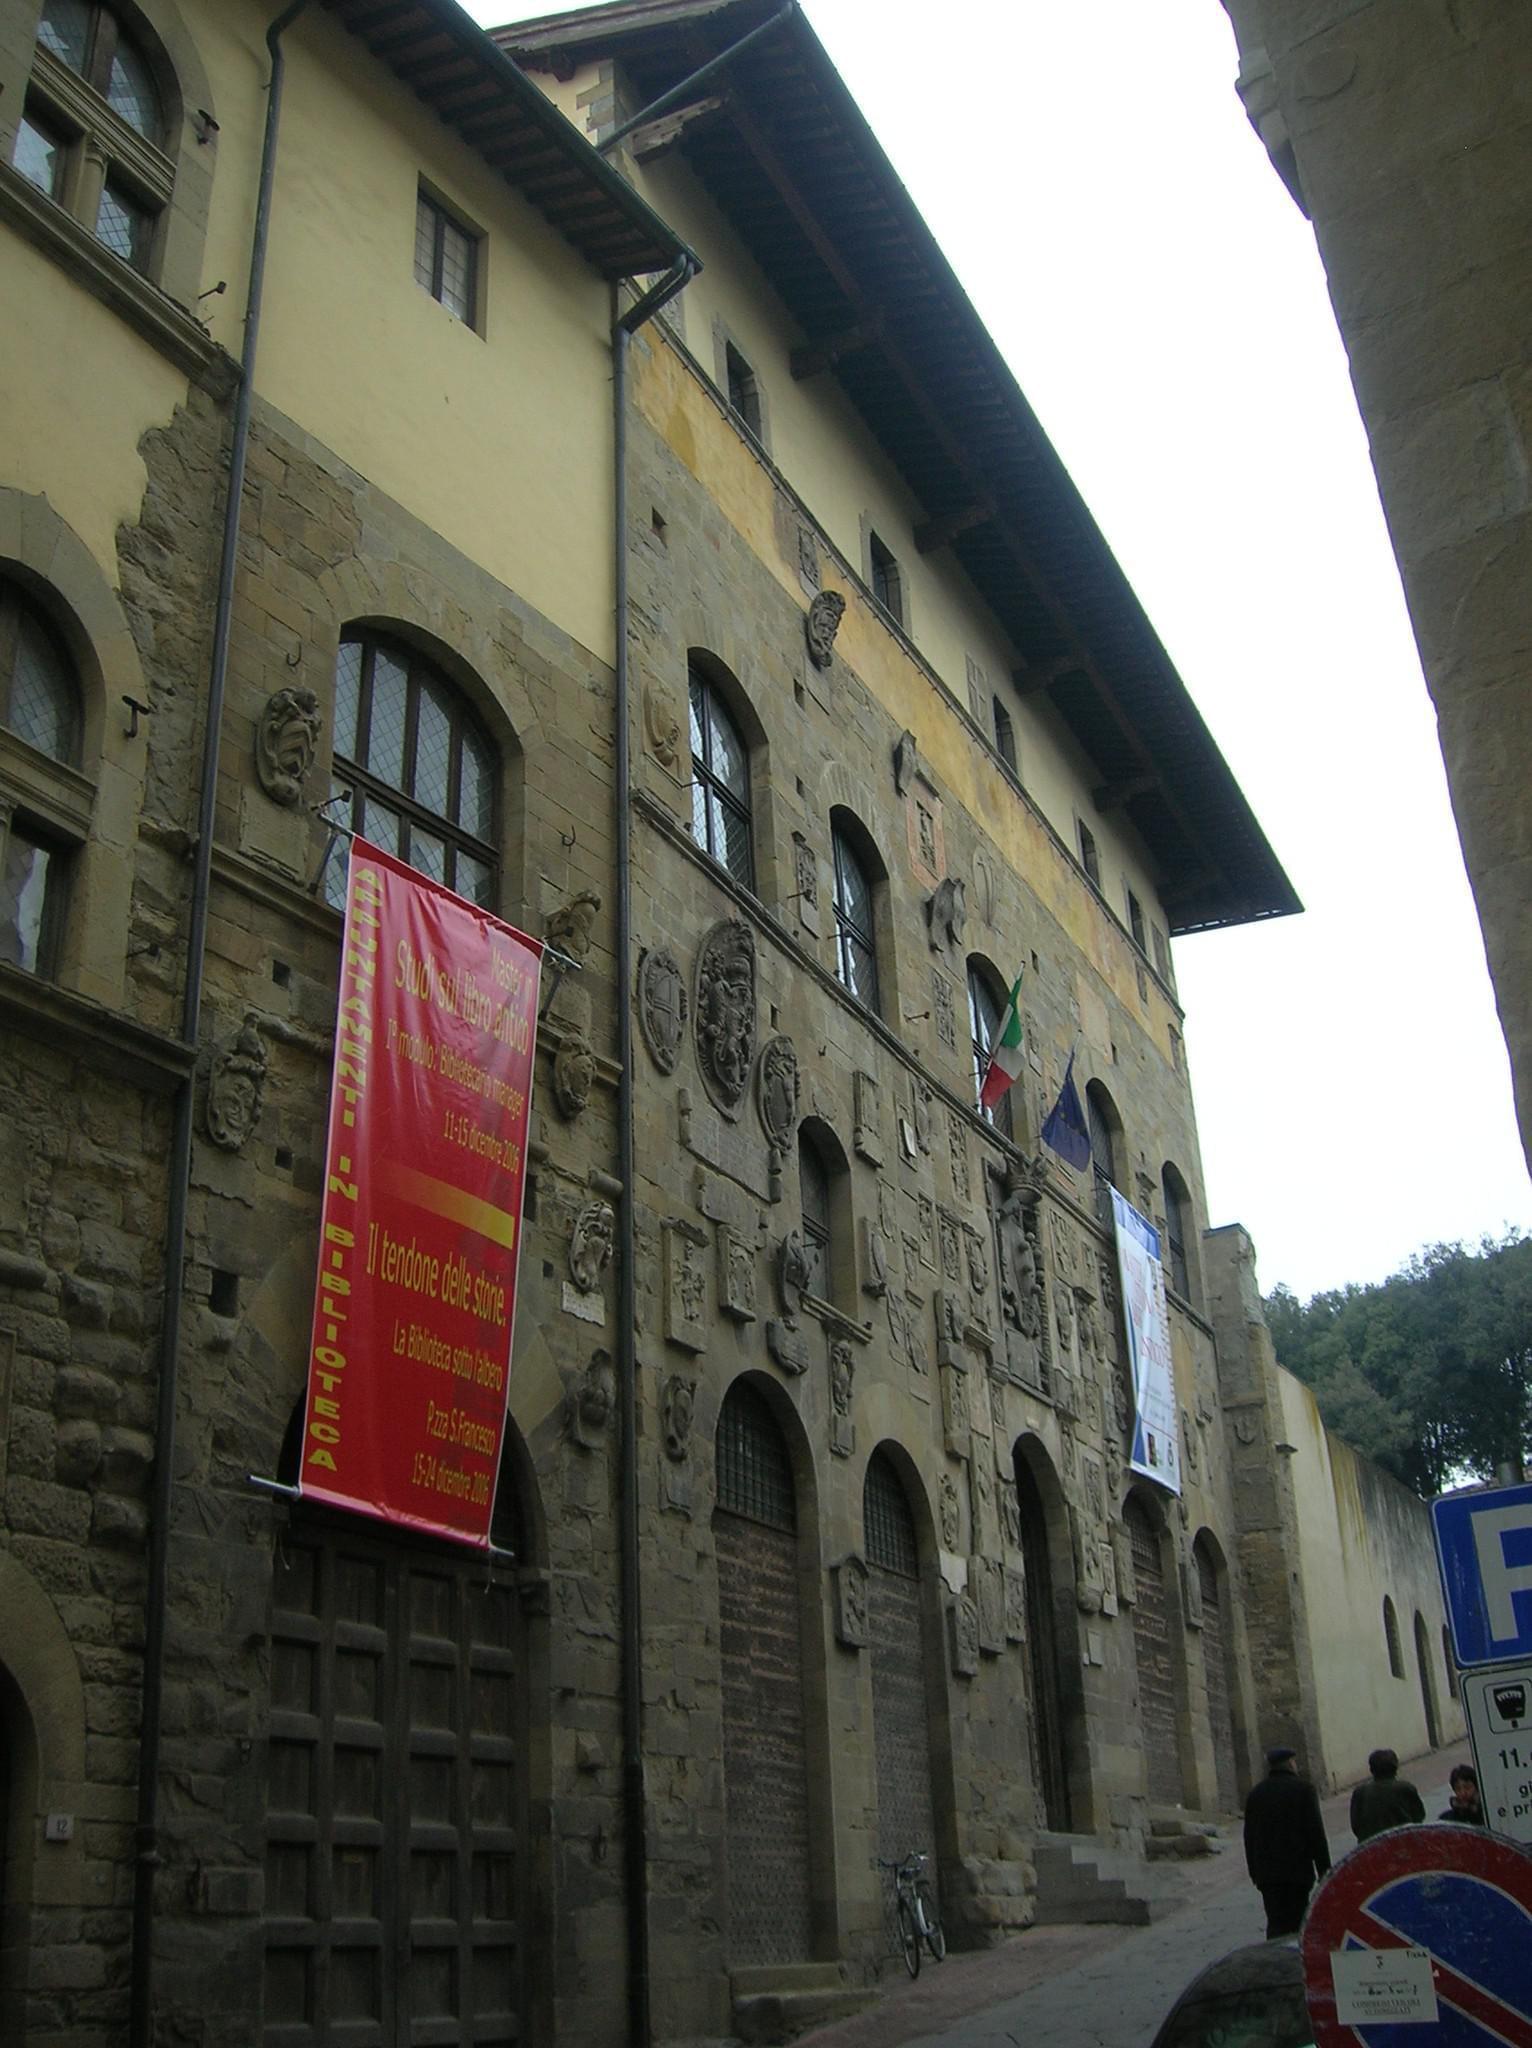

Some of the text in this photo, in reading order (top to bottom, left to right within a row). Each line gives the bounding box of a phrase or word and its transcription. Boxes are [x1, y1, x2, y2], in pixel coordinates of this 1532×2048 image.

[395, 939, 529, 1056] Studi sul libro antico
[491, 946, 522, 996] Master
[398, 1032, 437, 1071] modulo:
[440, 1043, 490, 1098] Bibliotecario
[493, 1079, 524, 1120] manager
[444, 1110, 468, 1146] 11-15
[469, 1122, 502, 1164] dicembre
[307, 868, 383, 1472] APPUNTAMENTI IN BIBLIOTECA
[366, 1222, 506, 1327] Il tendone delle storie.
[393, 1319, 503, 1392] La Biblioteca sotto l'albero
[427, 1400, 448, 1439] P.zza
[412, 1452, 436, 1488] 15-24
[436, 1460, 470, 1500] dicembre
[1499, 1747, 1532, 1769] 11.
[1497, 1800, 1532, 1818] e pr
